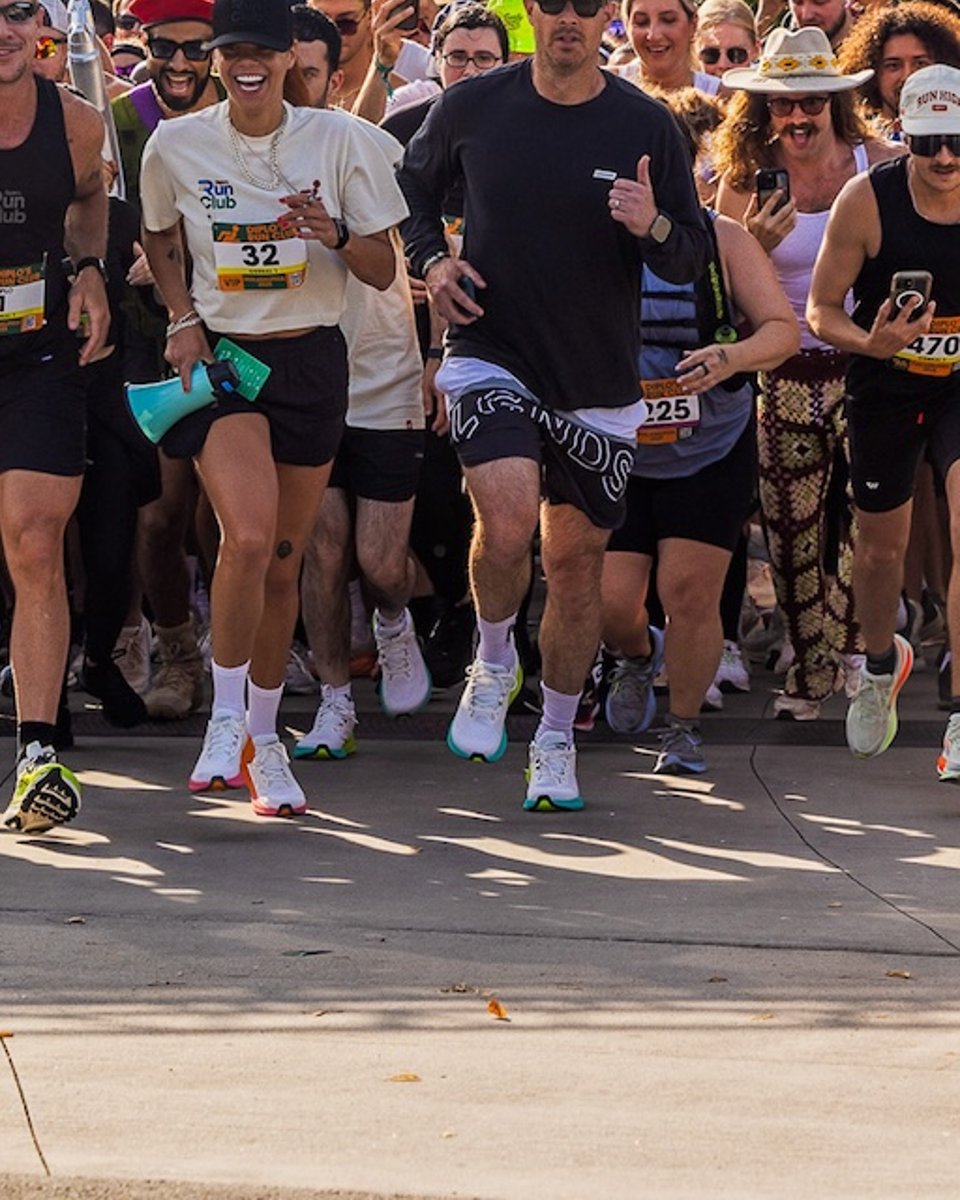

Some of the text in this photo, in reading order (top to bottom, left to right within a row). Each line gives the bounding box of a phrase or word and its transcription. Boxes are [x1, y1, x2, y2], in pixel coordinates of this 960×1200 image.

[940, 91, 960, 106] HIG
[198, 180, 233, 195] Run
[200, 195, 236, 210] Club
[241, 244, 280, 267] 32
[907, 336, 959, 356] 470
